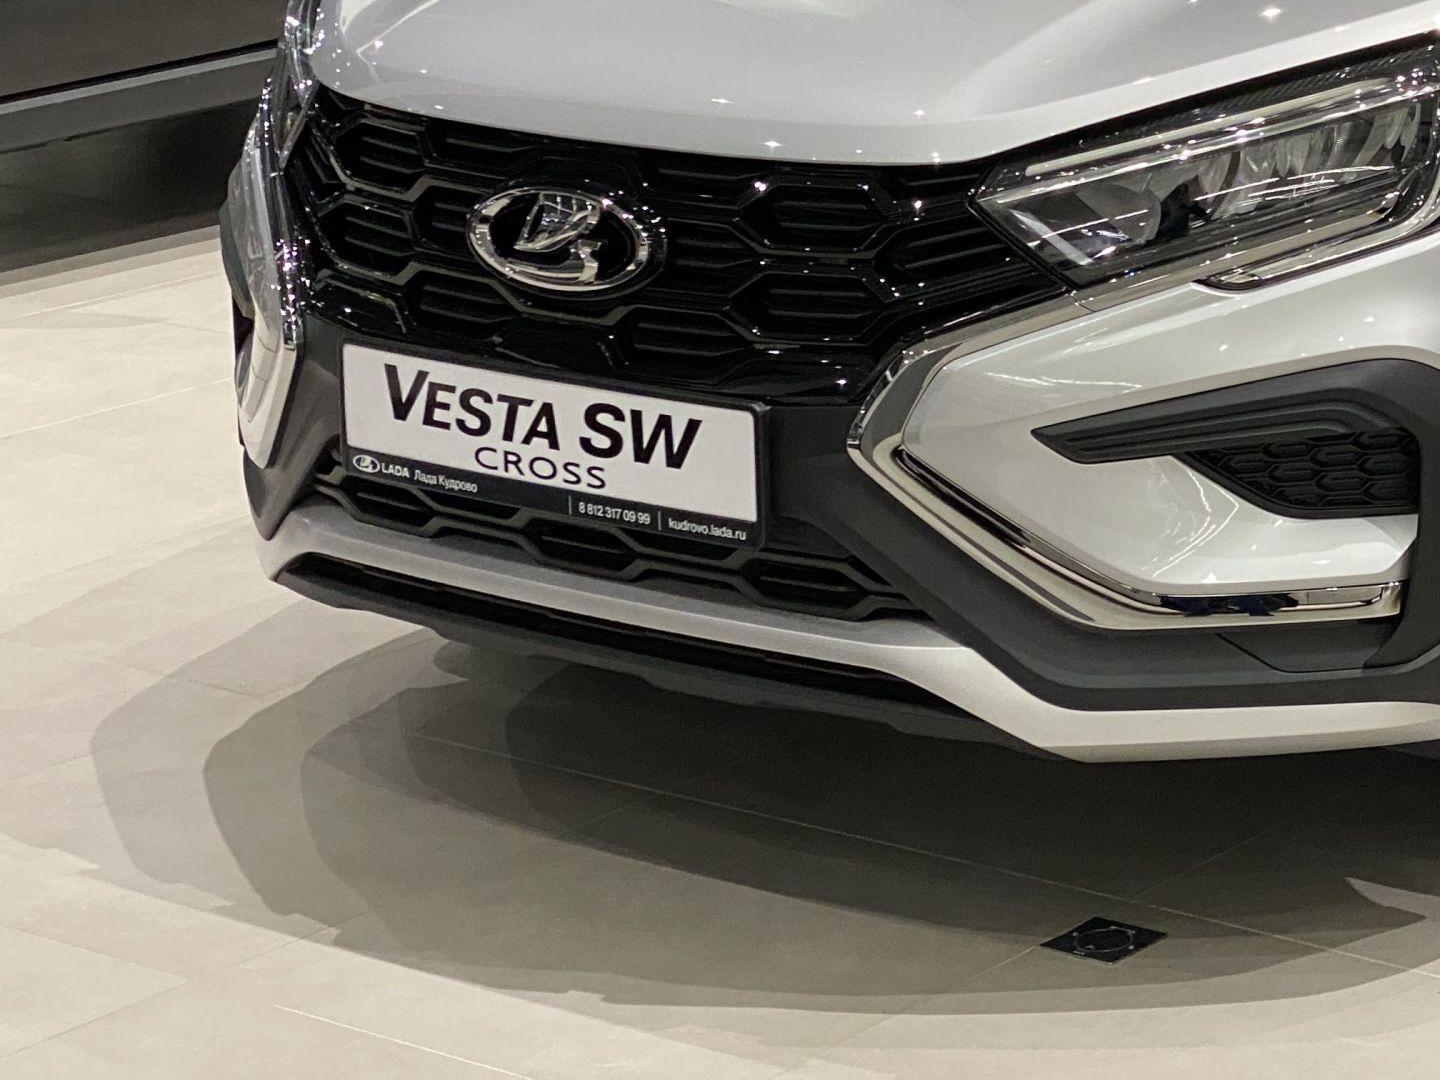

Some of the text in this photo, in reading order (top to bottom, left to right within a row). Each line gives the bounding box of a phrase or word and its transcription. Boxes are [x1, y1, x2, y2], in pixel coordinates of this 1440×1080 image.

[383, 362, 703, 469] VESTA SW
[381, 462, 410, 478] LADA
[474, 446, 607, 489] CROSS
[413, 469, 478, 493] Лада Кудрово
[578, 502, 651, 525] 8 812 317 09 99
[668, 517, 746, 541] kudrovo.lada.ru
